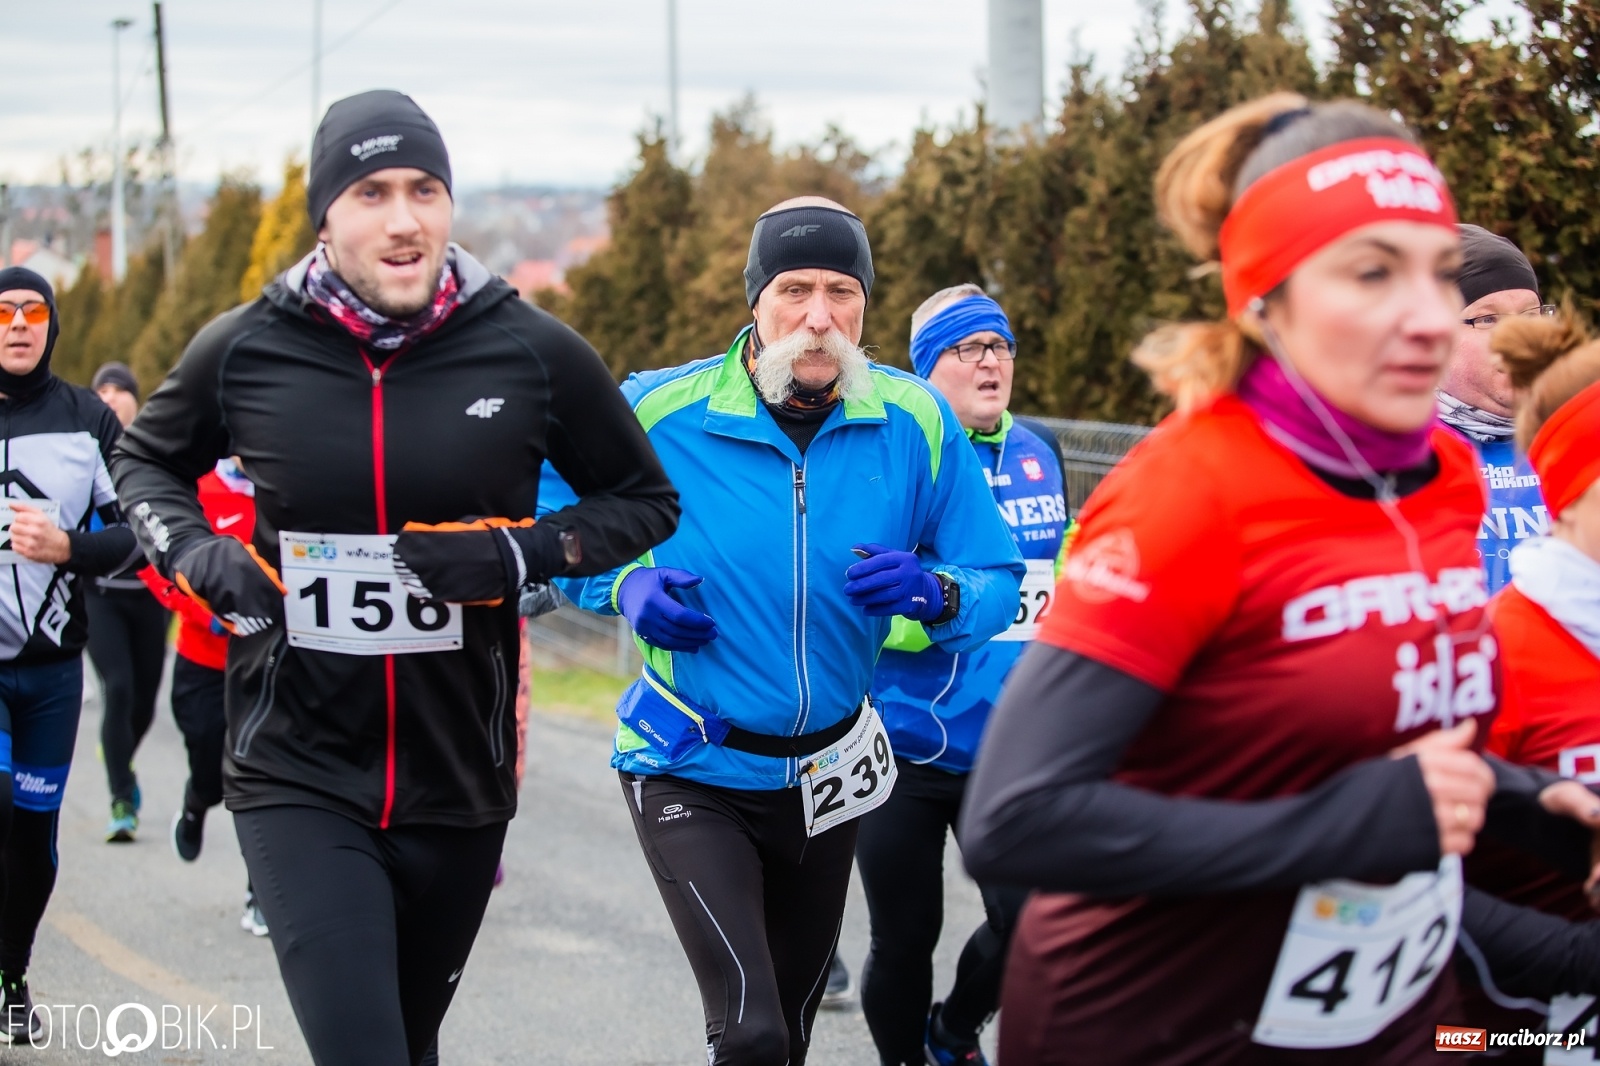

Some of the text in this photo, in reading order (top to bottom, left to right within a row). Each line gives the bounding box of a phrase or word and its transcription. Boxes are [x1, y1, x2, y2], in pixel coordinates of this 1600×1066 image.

[465, 398, 505, 418] 4F
[1022, 528, 1057, 541] TEAM
[299, 576, 451, 632] 156
[811, 731, 890, 820] 239
[1287, 913, 1448, 1014] 412
